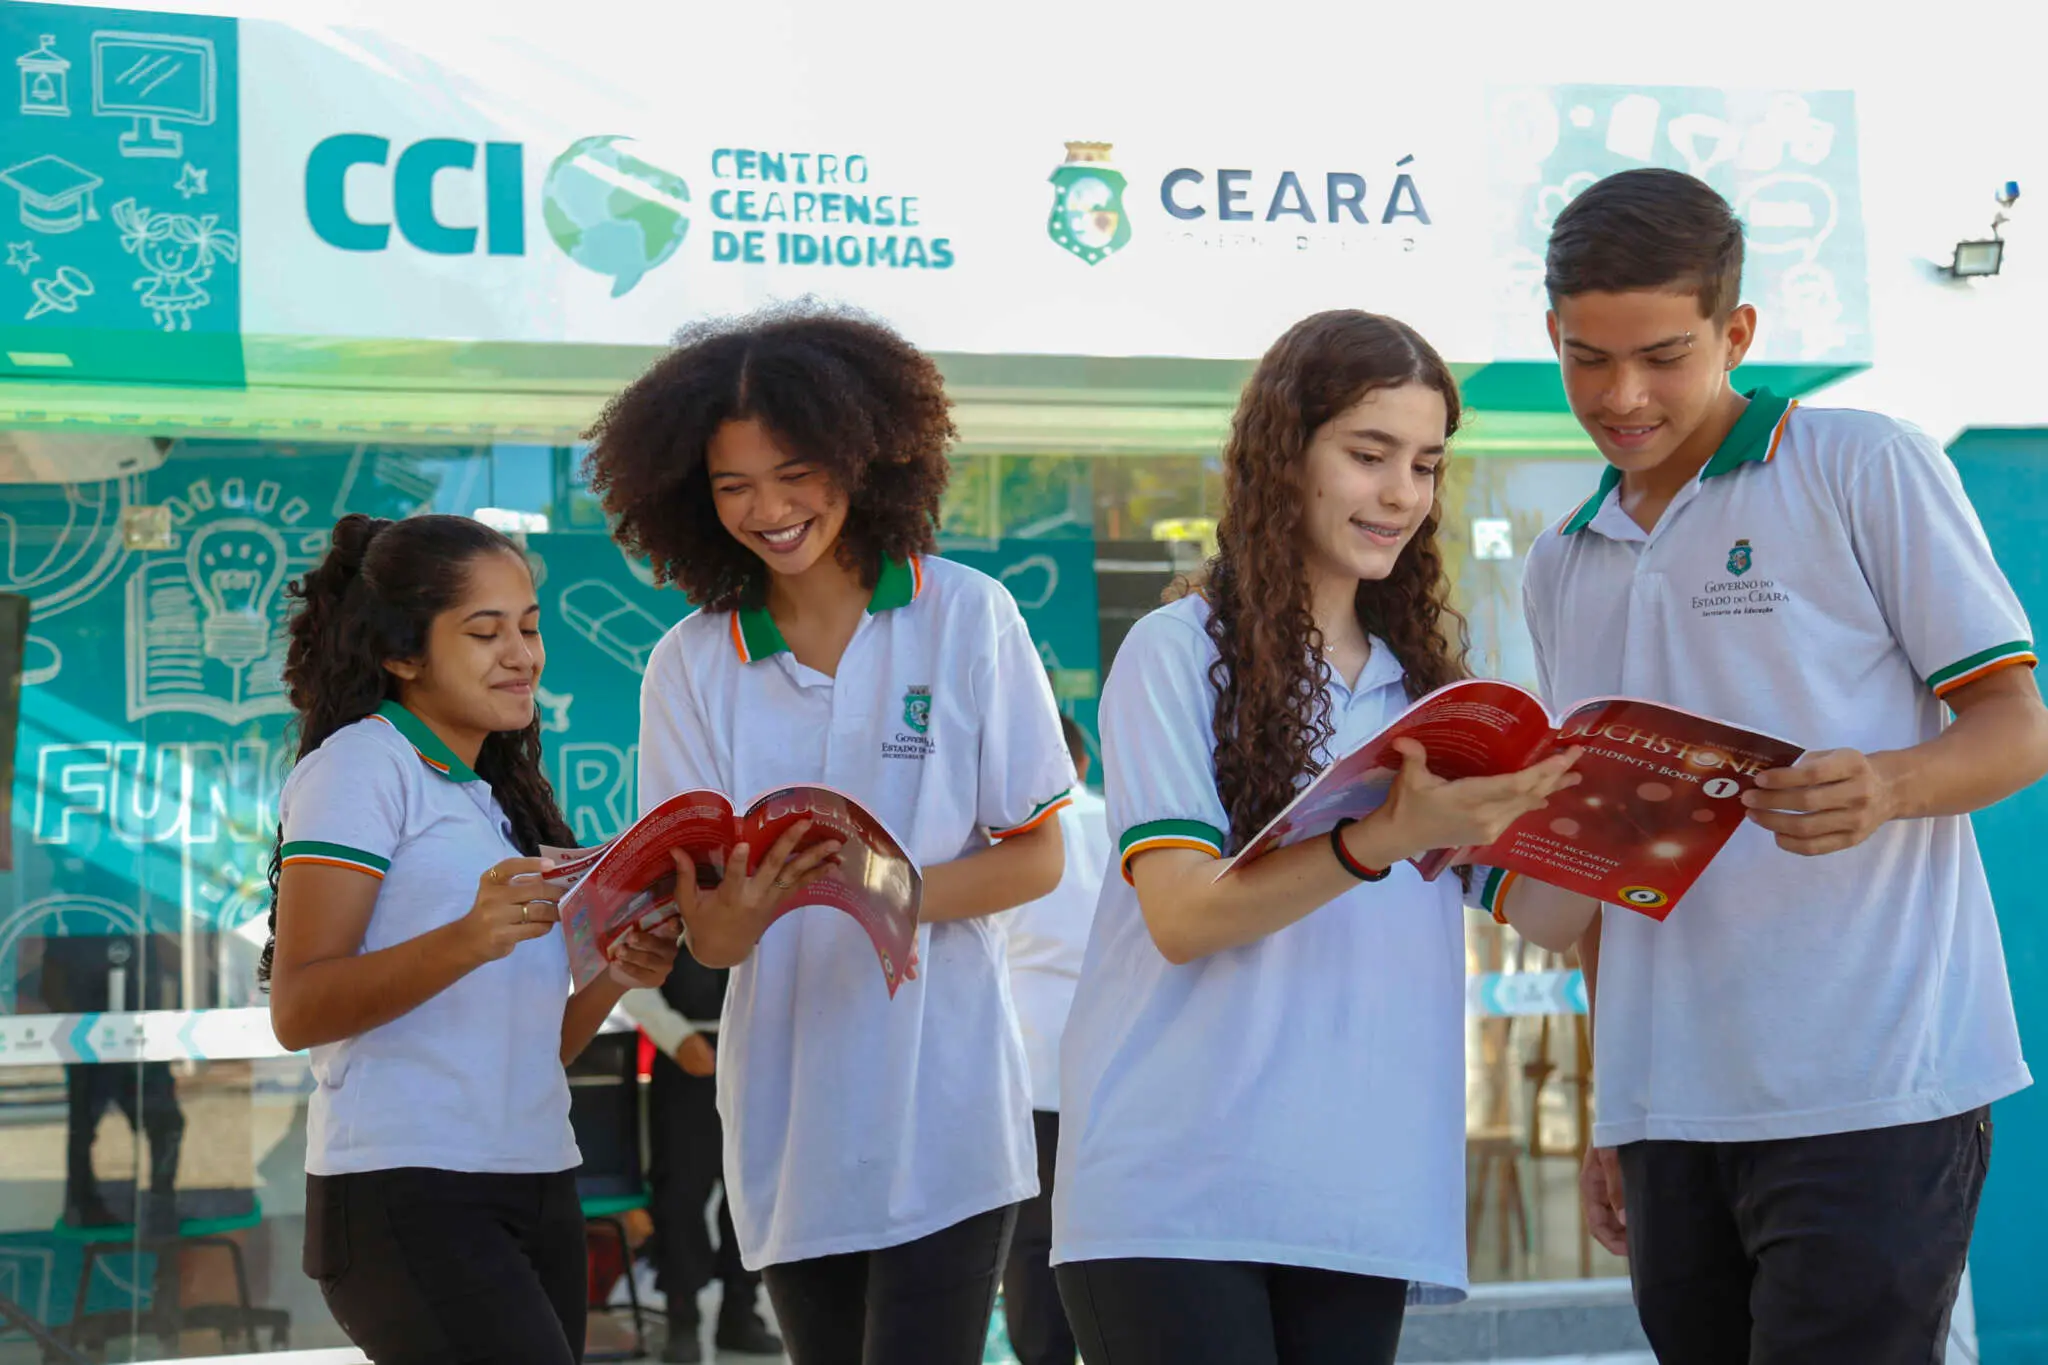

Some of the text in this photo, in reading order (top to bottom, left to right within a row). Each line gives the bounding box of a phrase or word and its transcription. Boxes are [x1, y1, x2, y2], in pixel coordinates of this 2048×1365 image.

[711, 148, 869, 184] CENTRO
[304, 133, 525, 256] CCI
[1160, 154, 1433, 225] CEARÁ
[710, 190, 920, 227] CEARENSE
[712, 230, 955, 270] DE IDIOMAS
[1692, 595, 1731, 609] ESTADO
[1704, 579, 1758, 594] GOVERNO
[1556, 721, 1773, 778] OUCHSTONE
[1660, 766, 1700, 783] BOOK
[1714, 781, 1729, 795] 1
